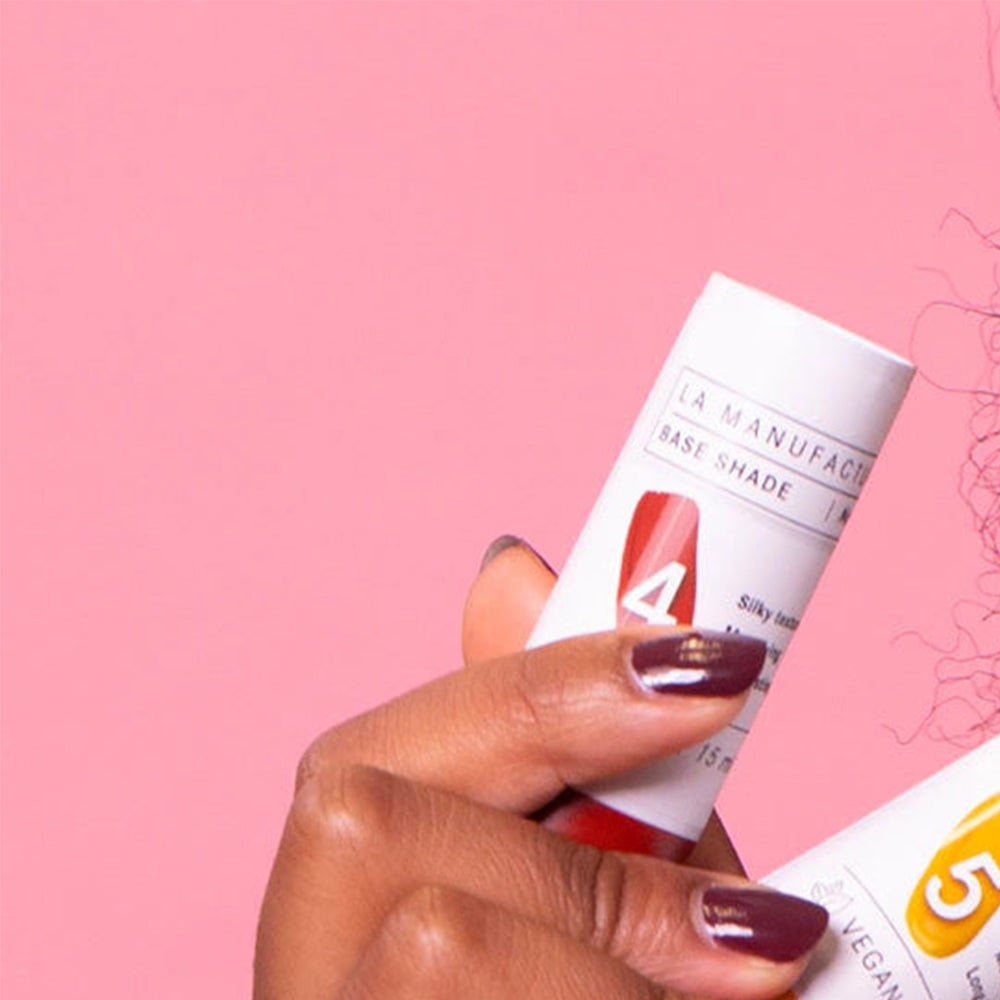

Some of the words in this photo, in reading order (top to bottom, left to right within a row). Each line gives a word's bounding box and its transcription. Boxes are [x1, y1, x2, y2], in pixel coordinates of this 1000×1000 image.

[678, 383, 706, 411] LA
[658, 424, 707, 460] BASE
[715, 452, 793, 501] SHADE
[621, 560, 687, 625] 4
[737, 594, 773, 625] Silky
